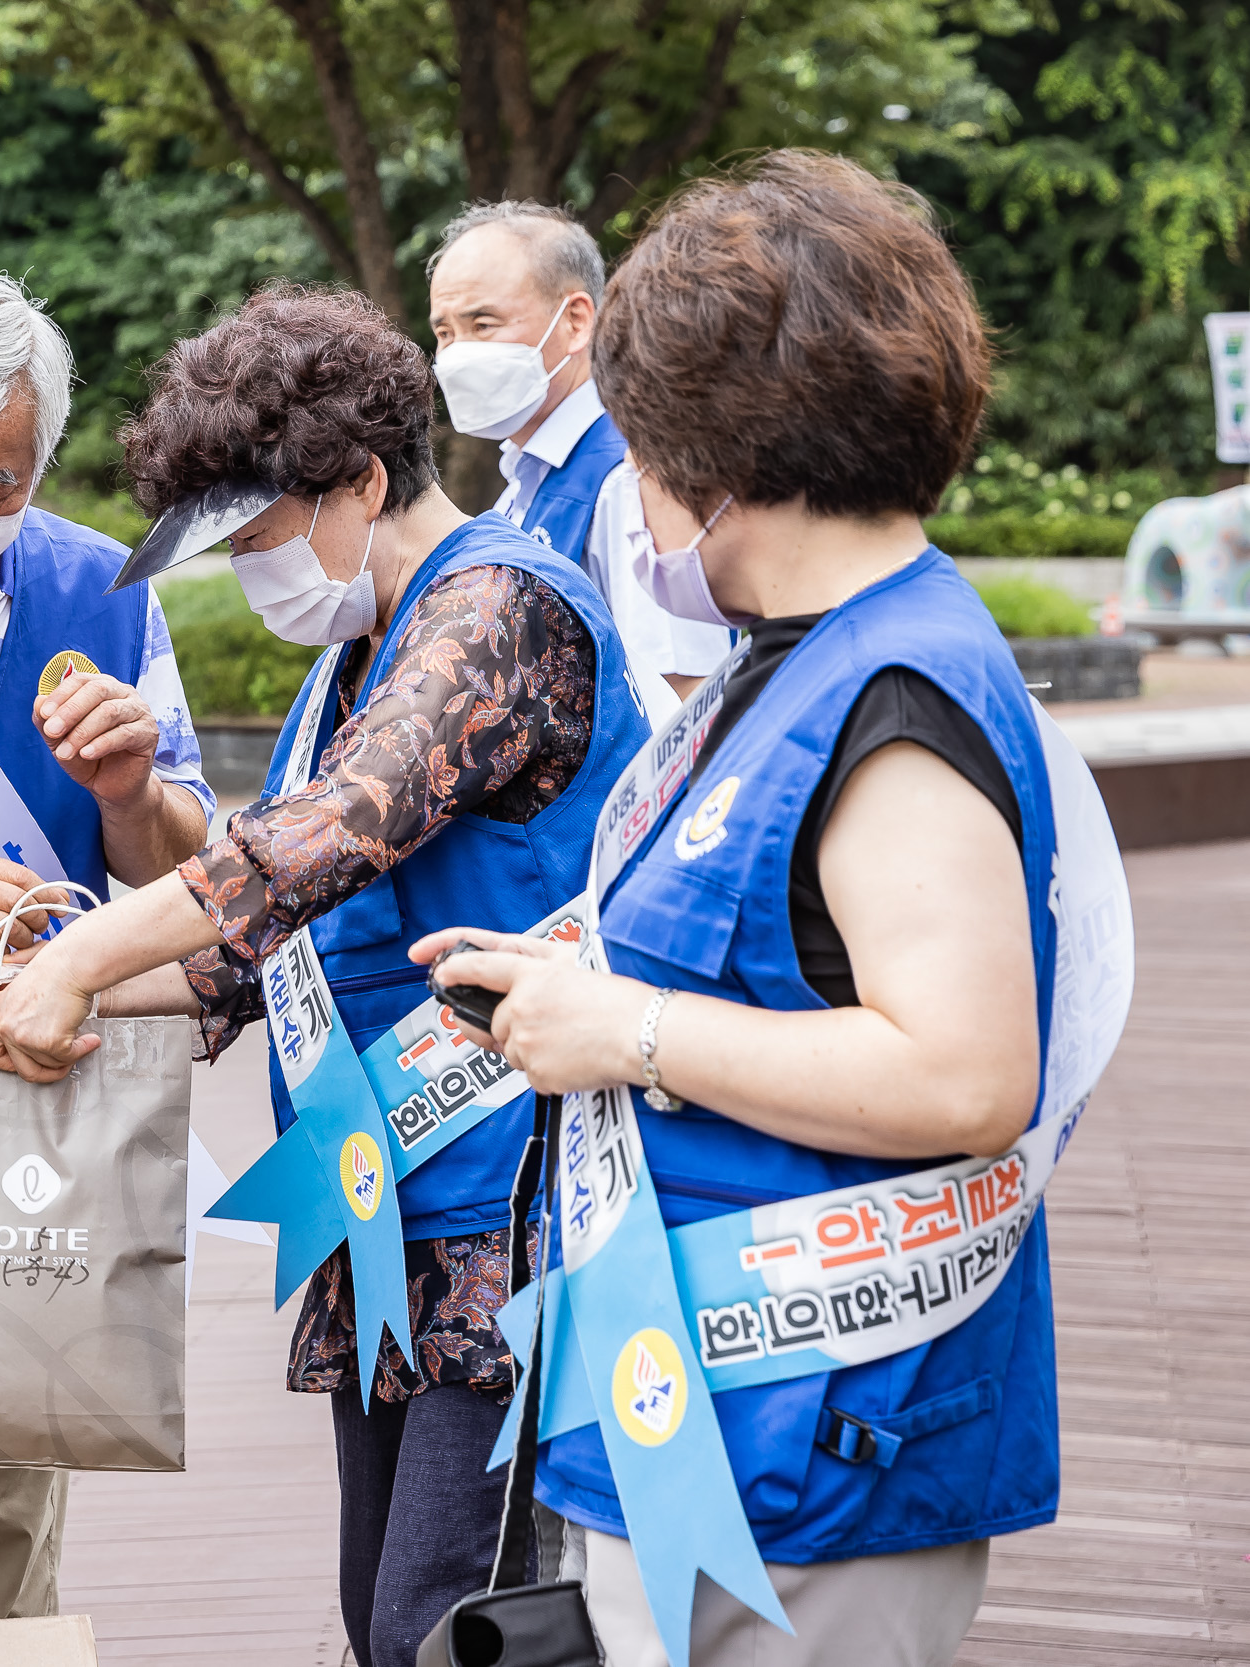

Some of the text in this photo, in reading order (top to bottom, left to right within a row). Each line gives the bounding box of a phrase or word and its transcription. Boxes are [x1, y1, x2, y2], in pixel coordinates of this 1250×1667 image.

[288, 938, 330, 1039] 키기
[390, 1050, 516, 1148] 협의회
[593, 1088, 633, 1202] 키기
[52, 1255, 88, 1267] STORE
[745, 1157, 1022, 1270] 철저히!
